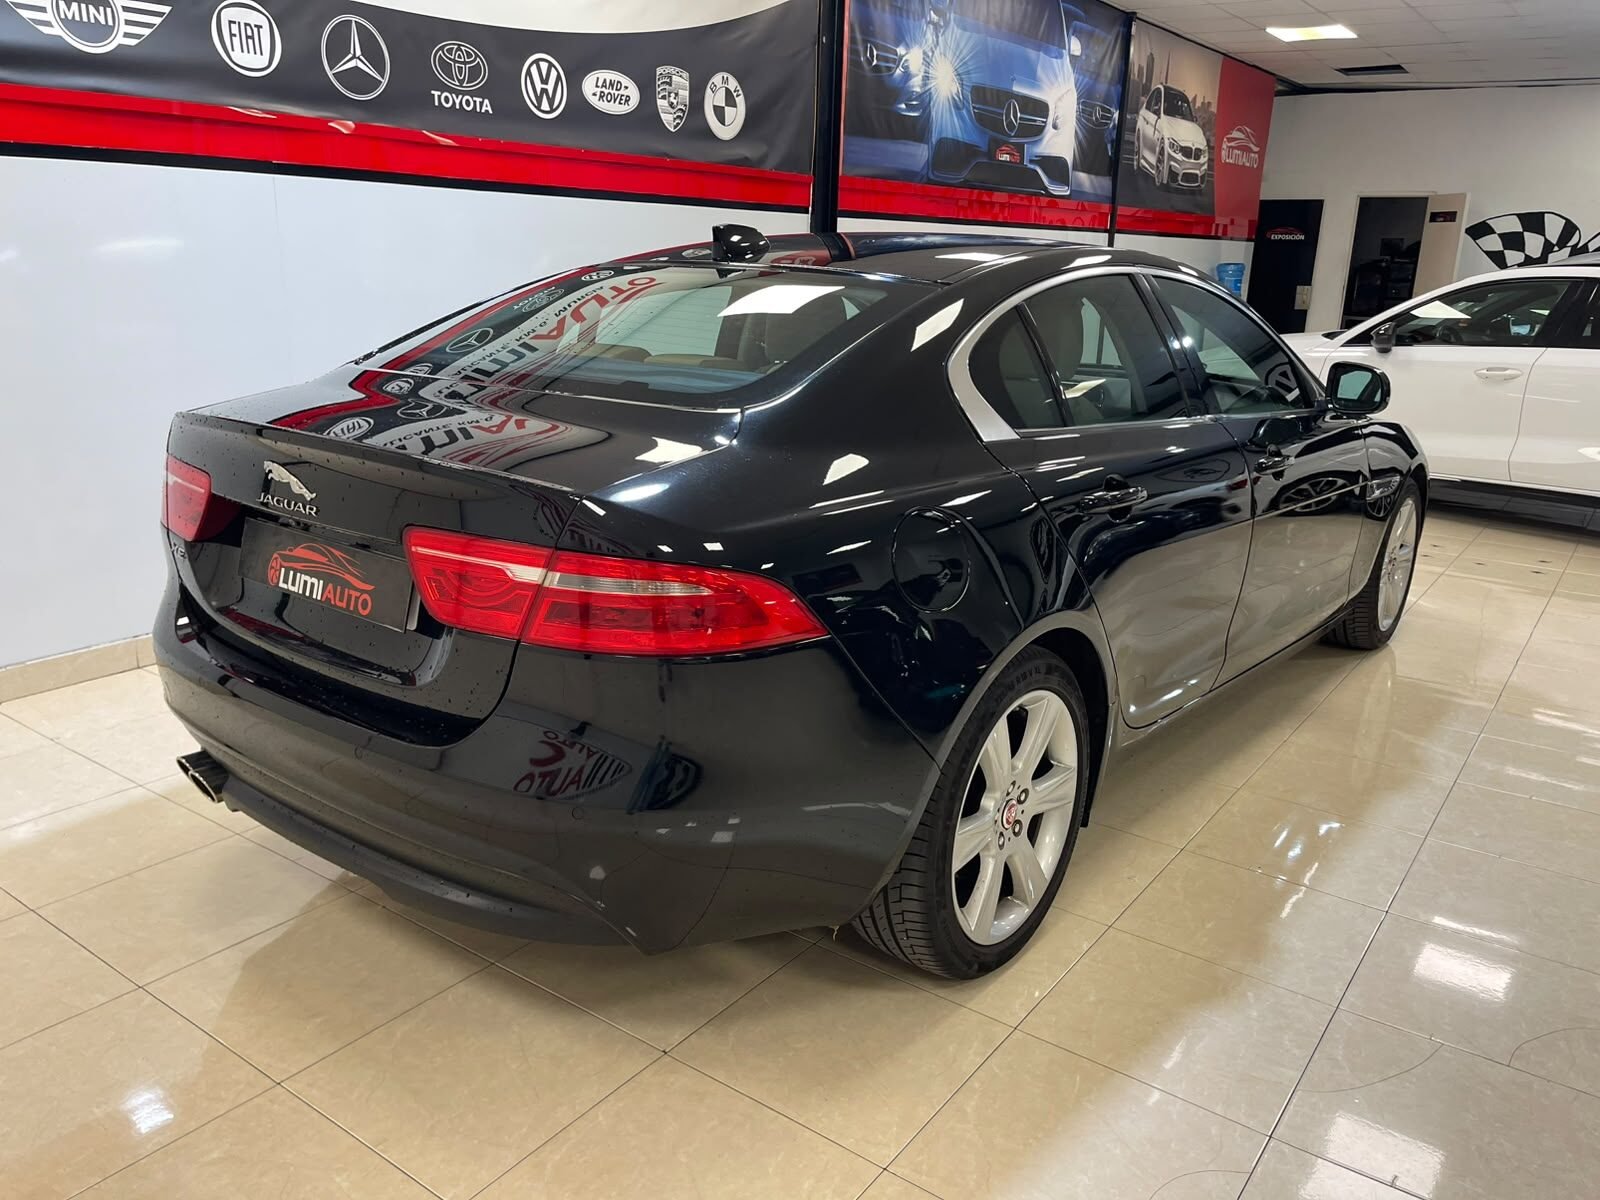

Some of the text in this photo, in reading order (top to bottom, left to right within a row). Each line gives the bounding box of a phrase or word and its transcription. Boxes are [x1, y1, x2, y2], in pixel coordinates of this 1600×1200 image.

[58, 0, 114, 26] MINI
[228, 20, 264, 57] FIAT
[594, 76, 622, 91] LAND
[709, 76, 742, 98] BMW
[431, 90, 493, 115] TOYOTA
[599, 91, 632, 107] ROVER
[1271, 231, 1305, 241] EXPOSICIÓN
[256, 490, 318, 518] JAGUAR
